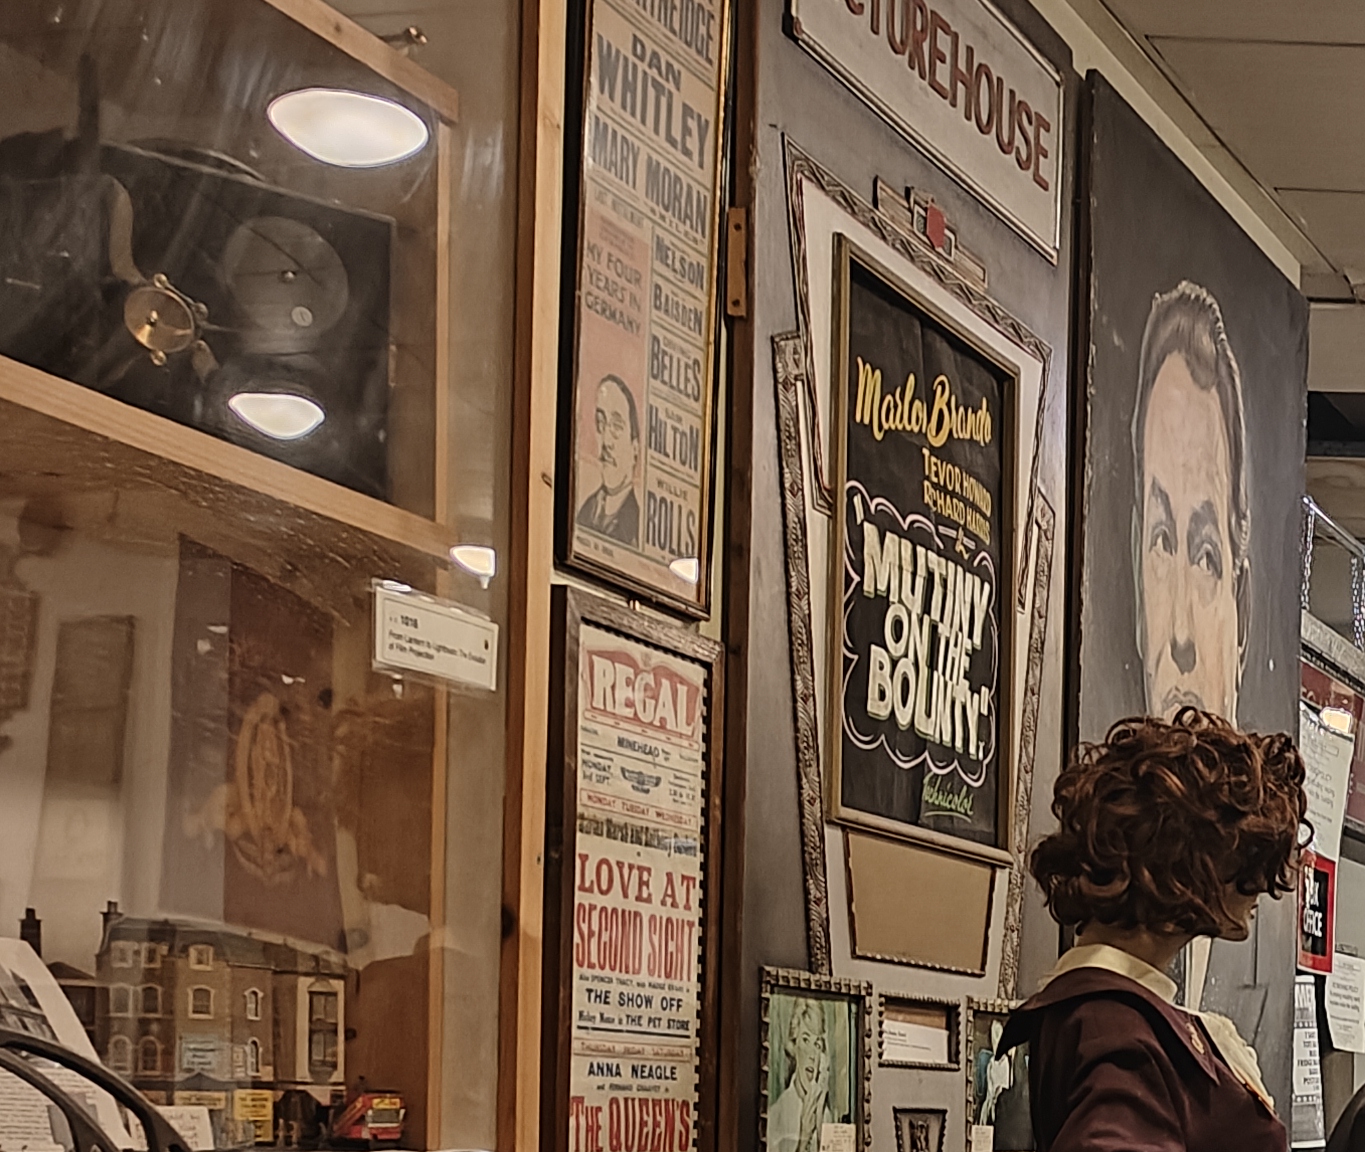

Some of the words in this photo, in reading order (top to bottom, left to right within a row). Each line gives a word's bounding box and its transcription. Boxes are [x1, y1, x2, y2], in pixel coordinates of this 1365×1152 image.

[632, 33, 682, 91] DAN
[596, 32, 709, 170] WHITLEY
[593, 115, 640, 190] MARY
[645, 153, 708, 240] MORAN
[587, 265, 626, 305] YEARS
[629, 291, 641, 313] IN
[606, 252, 643, 289] FOUR
[655, 235, 704, 292] NELSON
[585, 291, 641, 336] GERMANY
[653, 282, 703, 337] BAISDEN
[650, 333, 701, 404] BELLES
[855, 356, 928, 441] Marlon
[926, 373, 992, 447] Brando
[649, 402, 699, 473] HILTON
[656, 477, 689, 502] WILLIE
[646, 490, 695, 558] ROLLS
[884, 602, 930, 676] ON
[937, 621, 973, 697] THE
[591, 654, 694, 736] REGAL
[617, 735, 660, 758] MINEHEAD
[577, 853, 653, 904] LOVE
[660, 871, 697, 911] AT
[575, 901, 643, 976] SECOND
[647, 913, 695, 982] SIGHT
[1302, 908, 1323, 938] OFFICE
[585, 987, 612, 1006] THE
[617, 991, 655, 1010] SHOW
[660, 995, 684, 1013] OFF
[625, 1014, 643, 1027] THE
[647, 1016, 663, 1029] PET
[666, 1018, 690, 1032] STORE
[587, 1061, 623, 1079] ANNA
[630, 1064, 678, 1082] NEAGLE
[608, 1096, 691, 1152] QUEEN'S
